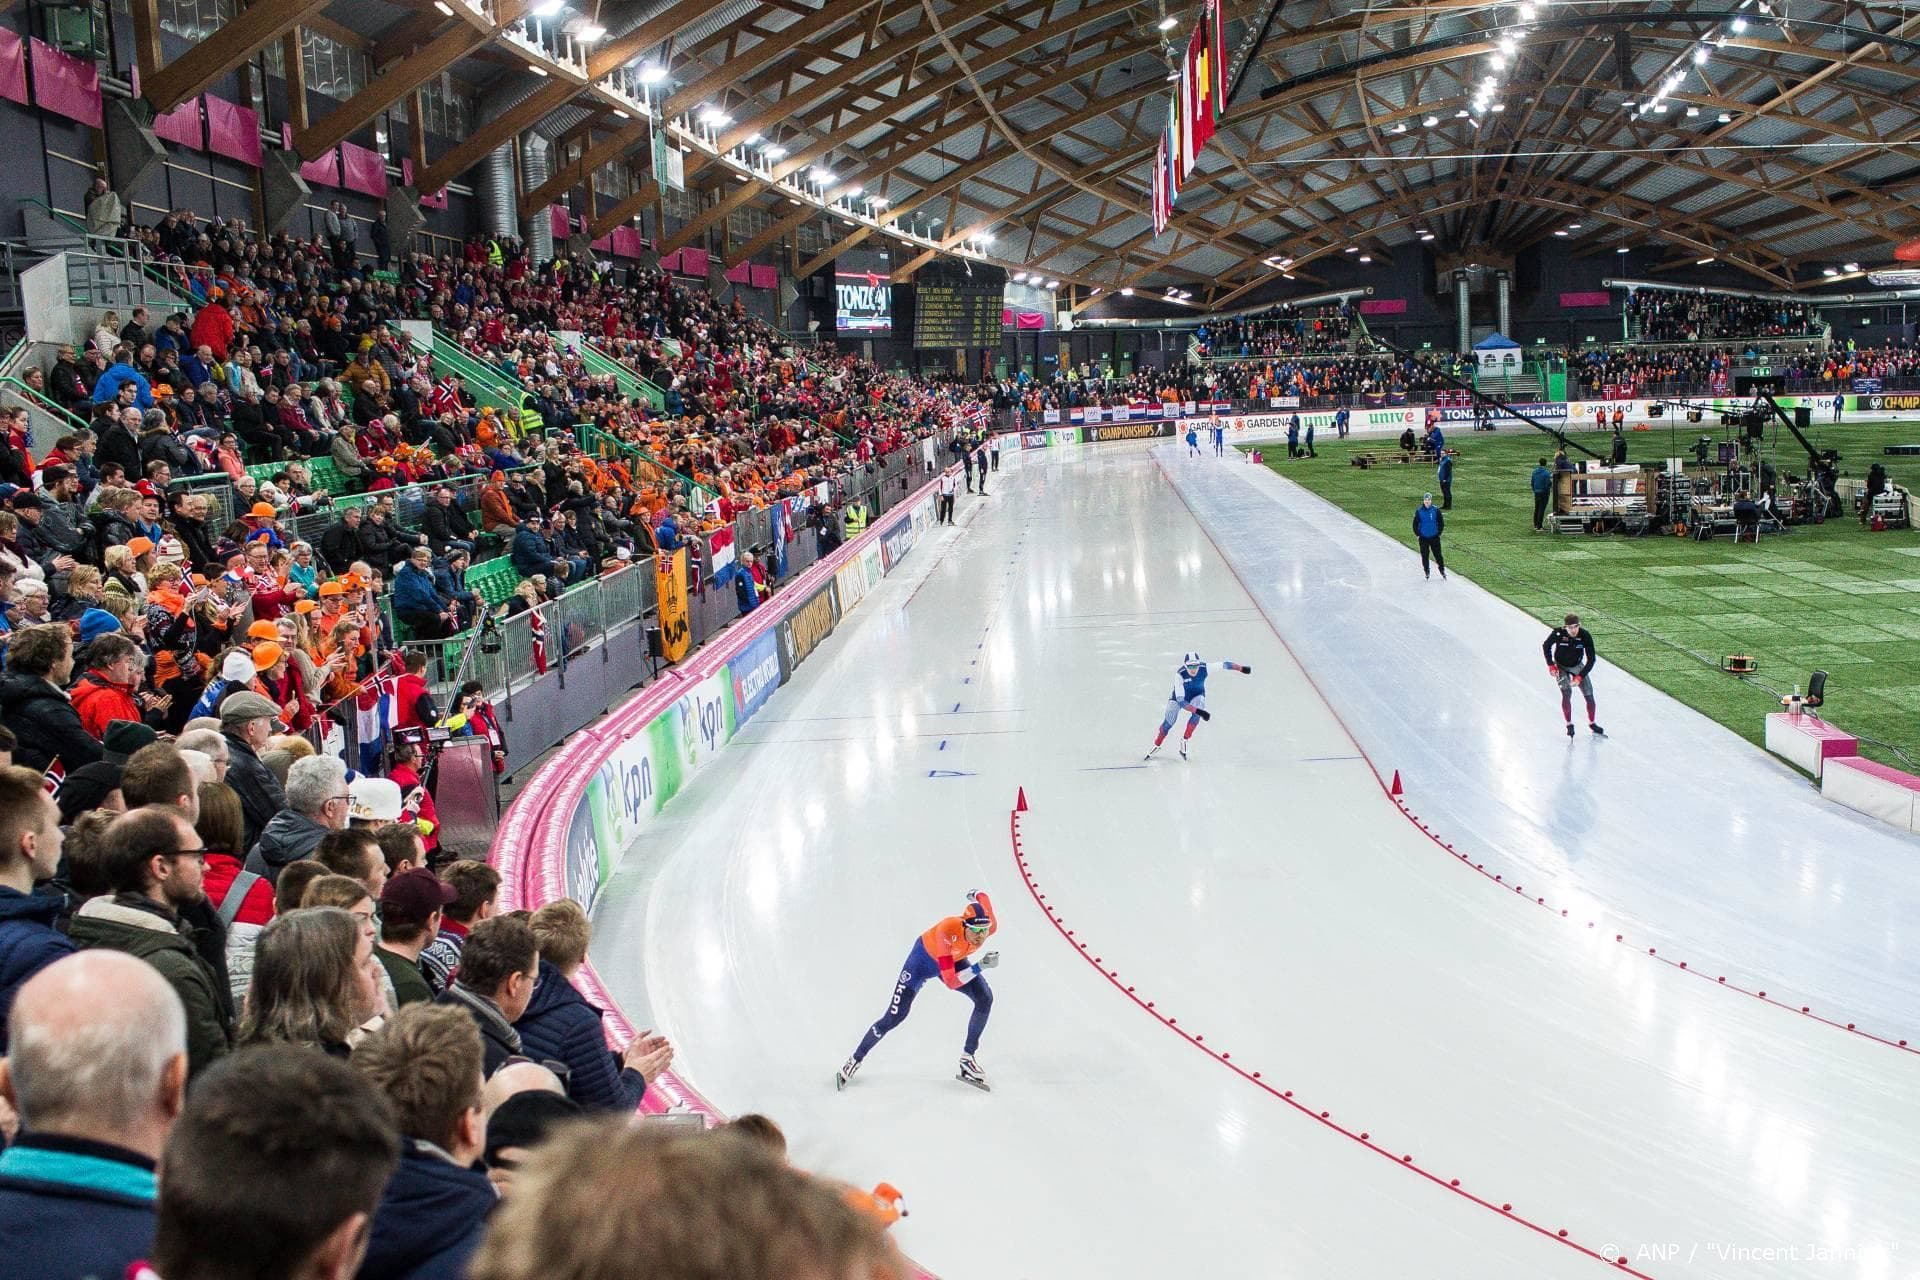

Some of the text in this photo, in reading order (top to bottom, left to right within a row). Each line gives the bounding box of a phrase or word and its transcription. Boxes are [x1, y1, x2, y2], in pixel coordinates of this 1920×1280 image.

[1817, 399, 1834, 410] kp
[1098, 424, 1155, 441] CHAMPIONSHIPS
[1247, 417, 1291, 429] GARDENA
[696, 695, 723, 751] kpn
[620, 756, 652, 825] kpn
[890, 984, 907, 1015] kpn
